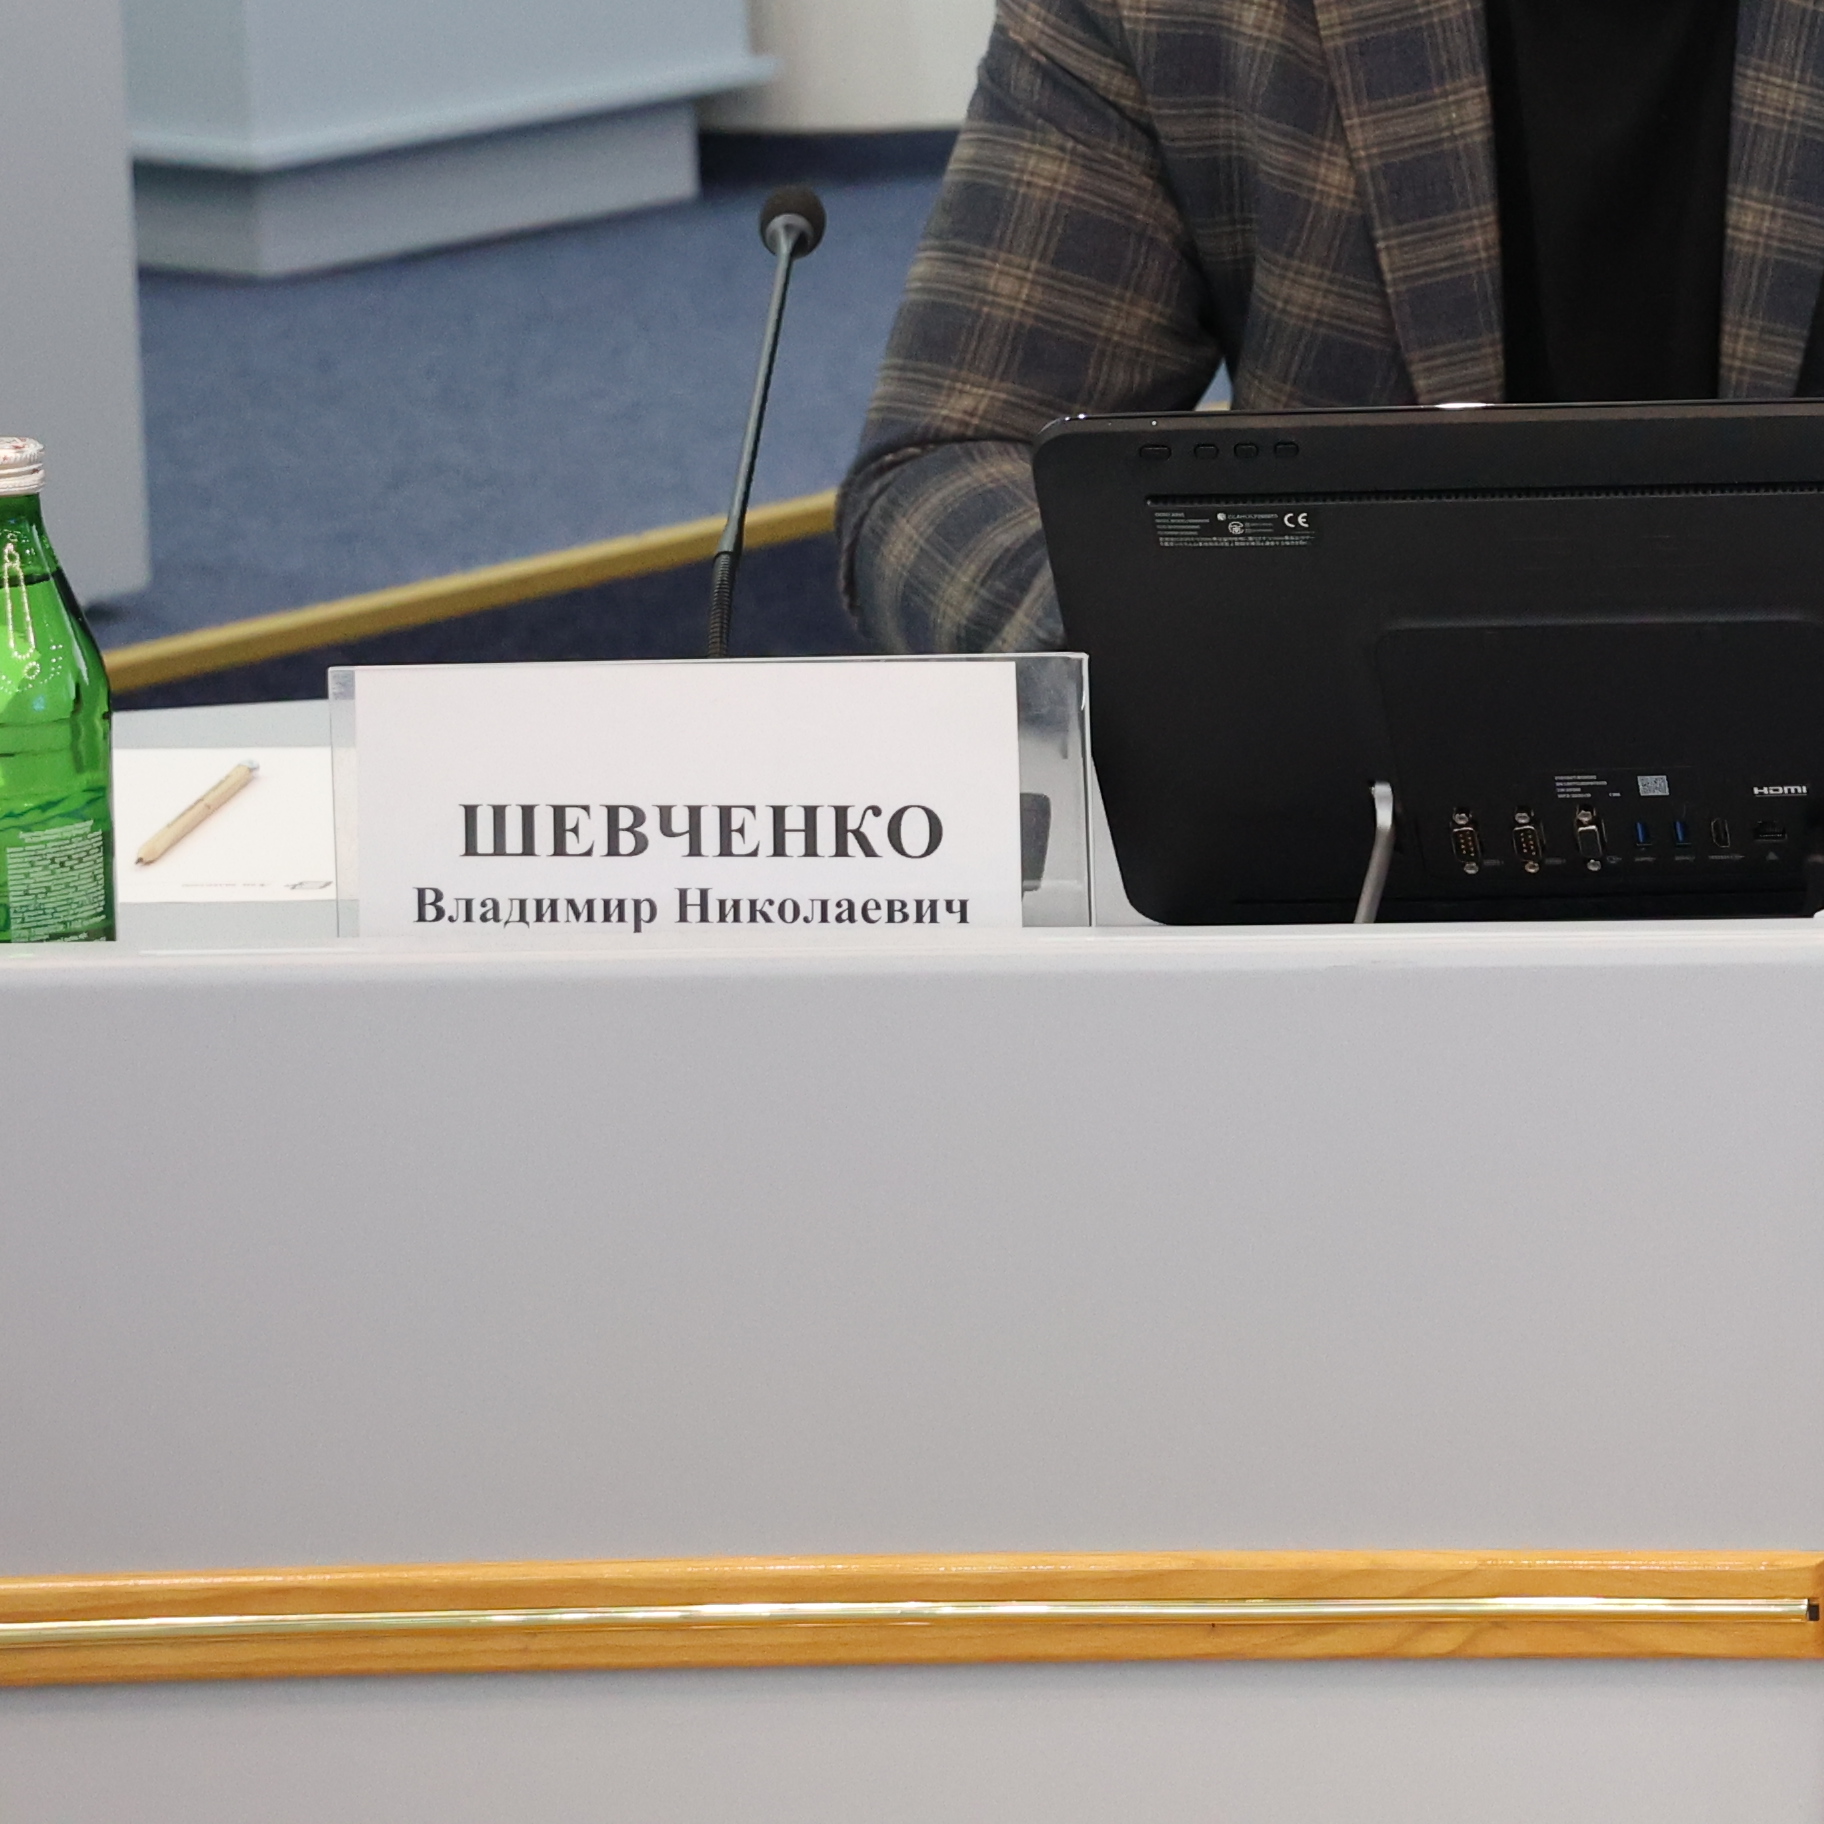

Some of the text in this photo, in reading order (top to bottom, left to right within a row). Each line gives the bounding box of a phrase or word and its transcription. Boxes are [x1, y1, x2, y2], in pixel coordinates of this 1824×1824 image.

[1753, 784, 1809, 795] HDMI
[460, 803, 945, 859] ШЕВЧЕНКО
[414, 887, 970, 933] Владимир Николаевич
